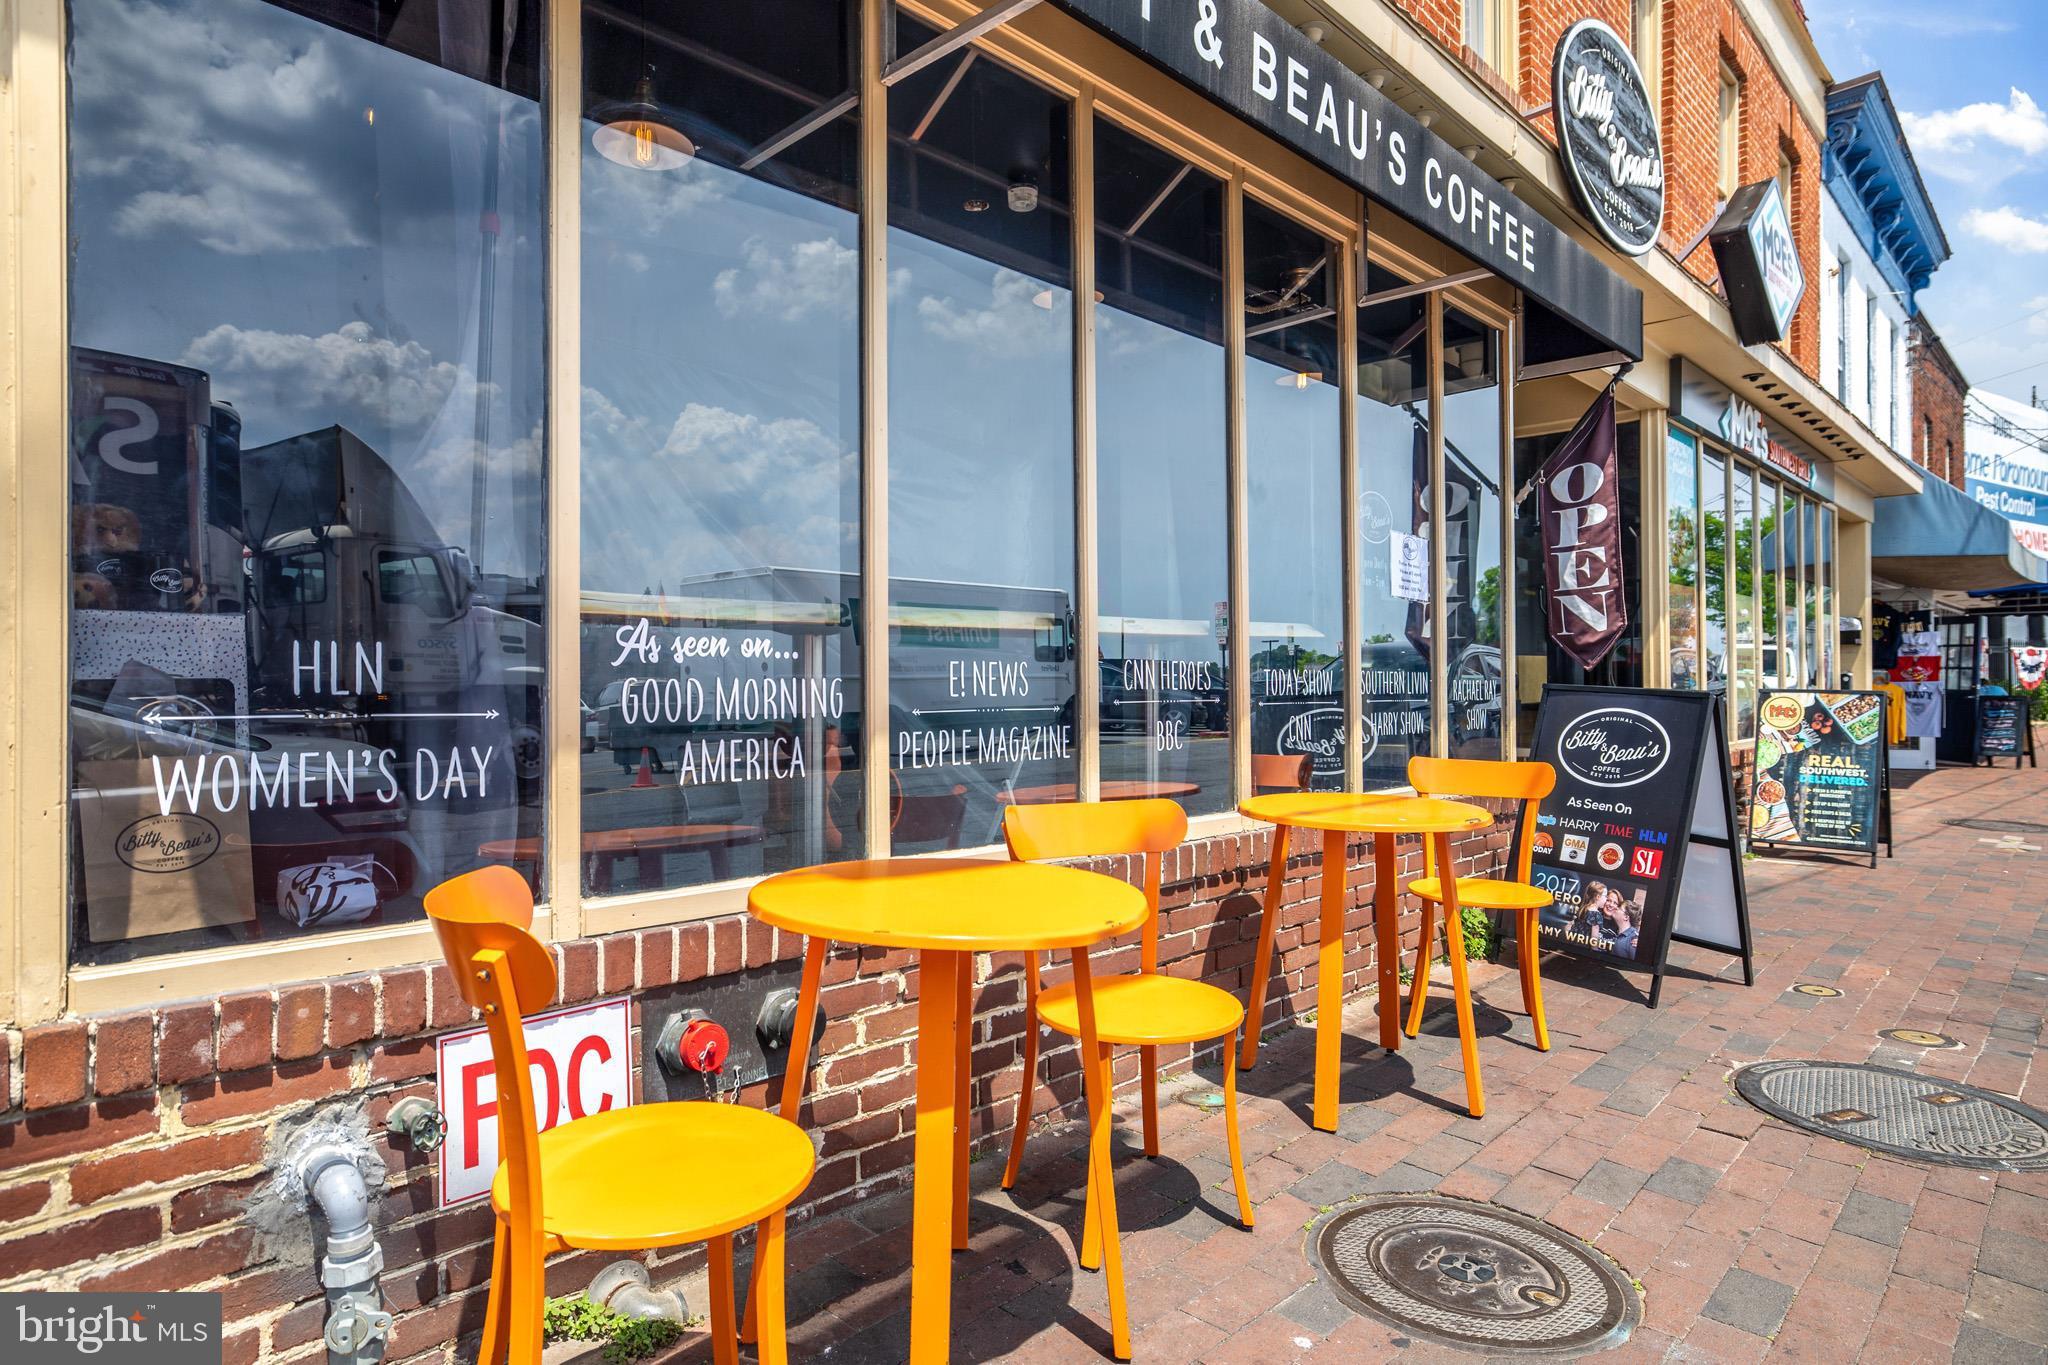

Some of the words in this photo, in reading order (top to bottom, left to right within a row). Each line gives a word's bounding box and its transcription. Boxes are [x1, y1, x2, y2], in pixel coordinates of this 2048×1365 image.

[1601, 47, 1635, 90] ORIGINAL
[1194, 0, 1224, 70] &
[1252, 31, 1406, 186] BEAU'S
[1425, 157, 1536, 273] COFFEE
[1567, 64, 1616, 139] Bitty
[1609, 136, 1663, 188] Beau's
[1603, 186, 1632, 218] COFFEE
[1603, 202, 1617, 222] EST
[1964, 451, 1990, 478] ome
[1993, 454, 2048, 494] Paramoun
[1975, 485, 1999, 511] Pest
[2000, 491, 2036, 517] Control
[1550, 462, 1614, 636] OPEN
[1872, 618, 1890, 627] AVY
[610, 617, 662, 667] As
[670, 634, 730, 664] seen
[739, 637, 799, 660] on...
[293, 640, 383, 695] HLN
[949, 660, 965, 698] E!
[972, 660, 1029, 697] NEWS
[1123, 659, 1155, 691] CNN
[1160, 660, 1212, 691] HEROES
[1264, 669, 1301, 696] TODAY
[1302, 669, 1334, 696] SHOW
[1360, 670, 1406, 696] SOUTHERN
[1407, 671, 1429, 695] LIVIN
[1452, 679, 1483, 702] RACHAEL
[1484, 679, 1497, 702] RAY
[621, 677, 704, 725] GOOD
[715, 676, 844, 722] MORNING
[1288, 715, 1312, 742] CNN
[1370, 711, 1399, 737] HARRY
[1400, 710, 1425, 736] SHOW
[1466, 708, 1488, 732] SHOW
[1600, 715, 1634, 724] ORIGINAL
[899, 729, 972, 770] PEOPLE
[978, 724, 1071, 765] MAGAZINE
[1156, 719, 1183, 752] BBC
[1565, 727, 1607, 751] Bitty
[1600, 740, 1661, 765] Beau's
[679, 735, 806, 786] AMERICA
[1592, 764, 1621, 774] COFFEE
[1799, 765, 1869, 778] SOUTHWEST.
[1808, 754, 1861, 769] REAL.
[152, 748, 399, 817] WOMEN'S
[415, 745, 494, 801] DAY
[1799, 773, 1869, 787] DELIVERED.
[1566, 796, 1582, 808] As
[1583, 798, 1613, 813] Seen
[1614, 803, 1633, 815] On
[123, 830, 162, 852] Bitty
[162, 832, 213, 857] Beau's
[1559, 816, 1600, 832] HARRY
[1603, 823, 1635, 839] TIME
[1638, 828, 1669, 845] HLN
[1532, 845, 1553, 855] ODAY
[1564, 838, 1587, 850] GMA
[1633, 849, 1657, 876] SL
[1535, 872, 1580, 895] 2017
[1538, 924, 1562, 938] AMY
[1566, 930, 1616, 951] WRIGHT
